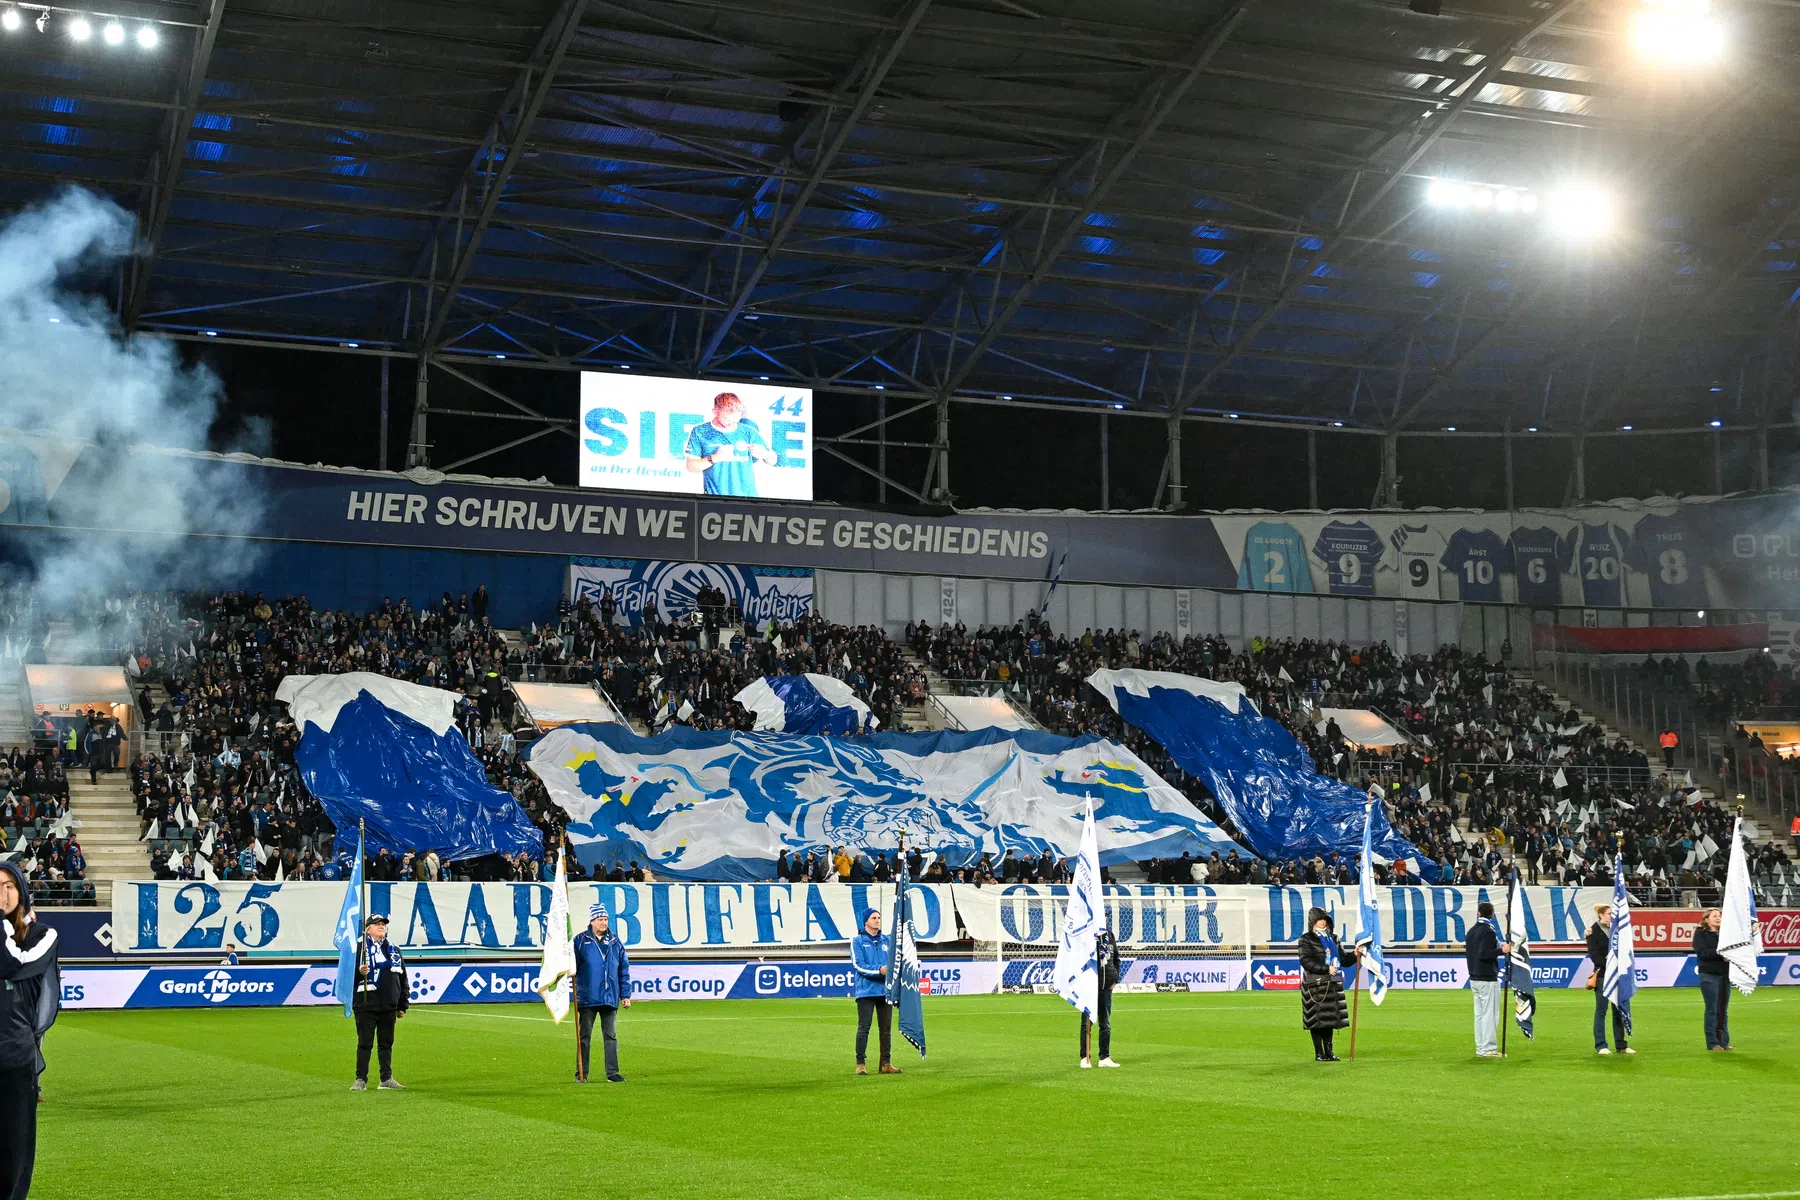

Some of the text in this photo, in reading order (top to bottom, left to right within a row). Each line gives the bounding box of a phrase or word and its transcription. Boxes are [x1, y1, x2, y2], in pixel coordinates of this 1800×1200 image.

[768, 395, 803, 417] 44
[347, 491, 1049, 559] HIER SCHRIJVEN WE GENTSE GESCHIEDENIS
[1263, 552, 1285, 584] 2
[1339, 554, 1361, 584] 9
[1408, 559, 1429, 587] 9
[1463, 561, 1494, 585] 10
[1527, 558, 1547, 583] 6
[1584, 557, 1619, 580] 20
[1659, 550, 1689, 585] 8
[129, 883, 283, 950] 125
[159, 980, 275, 993] Gent Motors
[668, 976, 725, 996] Group
[783, 970, 854, 988] telenet
[1166, 972, 1227, 983] BACKLINE
[1395, 967, 1457, 982] telenet
